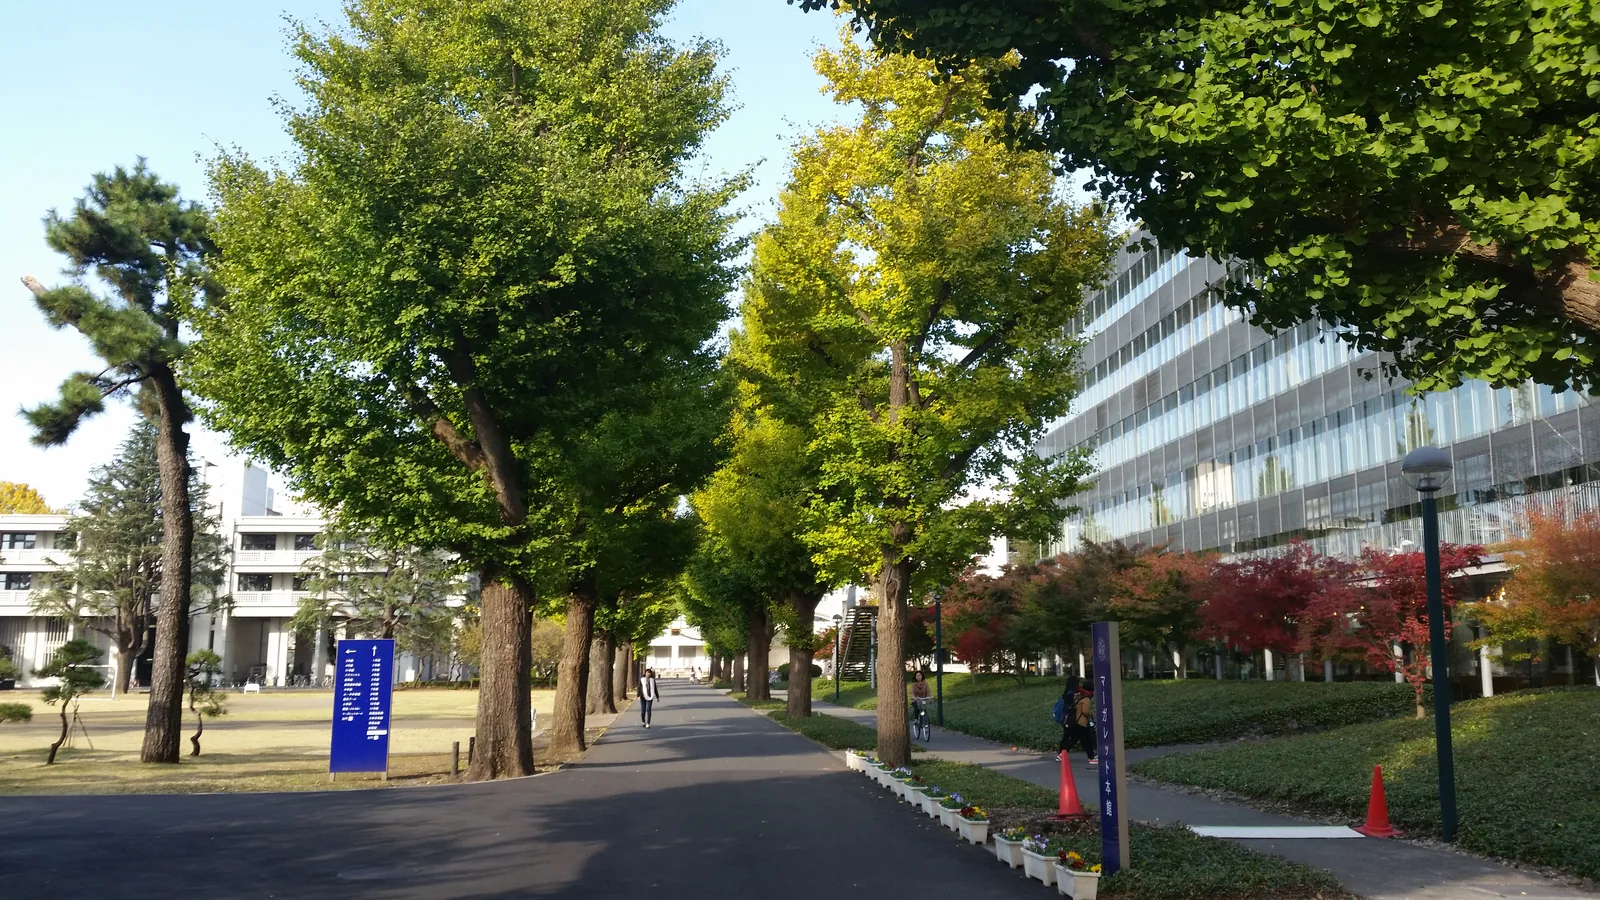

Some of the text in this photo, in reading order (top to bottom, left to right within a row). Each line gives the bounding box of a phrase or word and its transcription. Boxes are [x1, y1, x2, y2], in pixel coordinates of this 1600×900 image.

[1100, 675, 1113, 817] マーガレット本館
